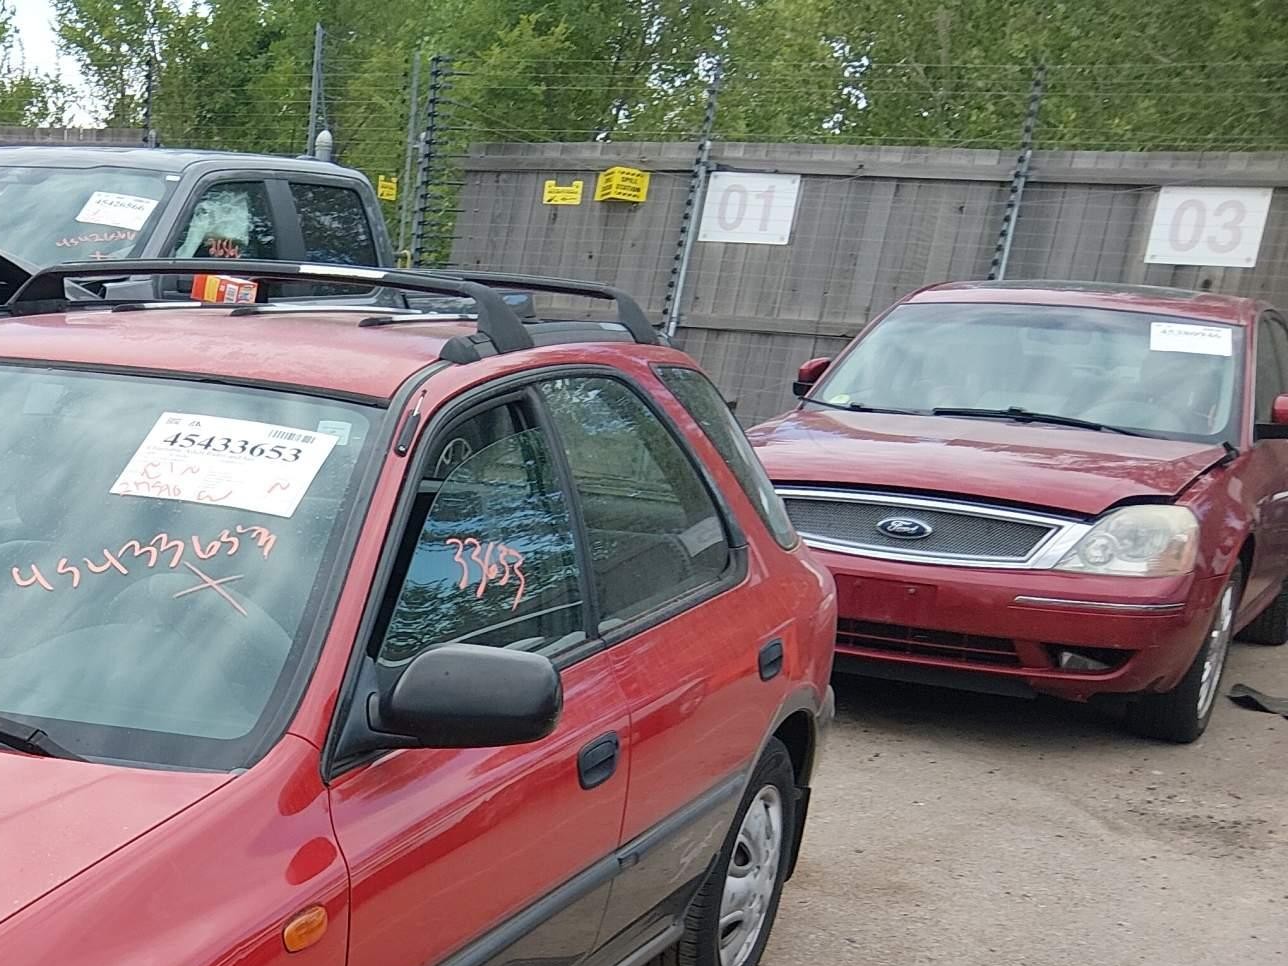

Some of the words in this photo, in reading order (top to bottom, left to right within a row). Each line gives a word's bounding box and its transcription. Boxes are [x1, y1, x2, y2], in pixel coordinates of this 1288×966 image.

[717, 183, 776, 232] 01
[1168, 198, 1248, 254] 03
[163, 431, 303, 463] 45433653
[886, 520, 920, 534] Ford
